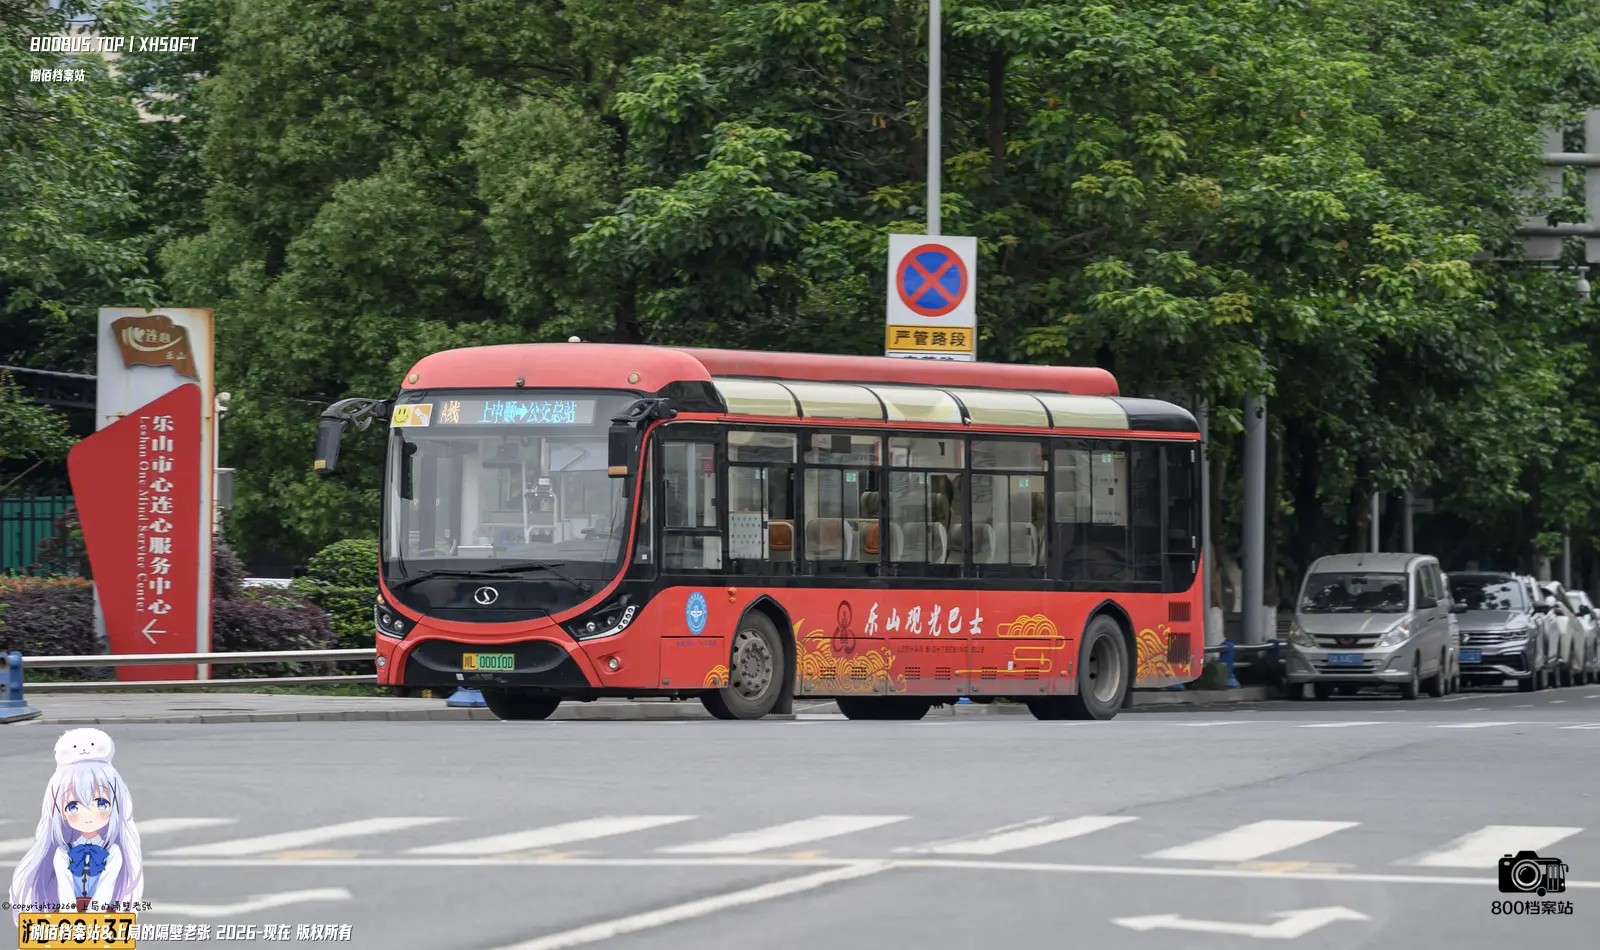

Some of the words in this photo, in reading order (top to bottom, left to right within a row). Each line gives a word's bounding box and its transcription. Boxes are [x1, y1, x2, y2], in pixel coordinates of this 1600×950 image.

[893, 329, 966, 347] 严管路段
[138, 416, 151, 457] Leshan
[138, 460, 150, 485] One
[137, 490, 150, 521] Mind
[147, 414, 175, 615] 乐山市心连心服务中心
[136, 525, 149, 568] Service
[136, 572, 148, 612] Center
[864, 602, 984, 636] 乐山观光巴士
